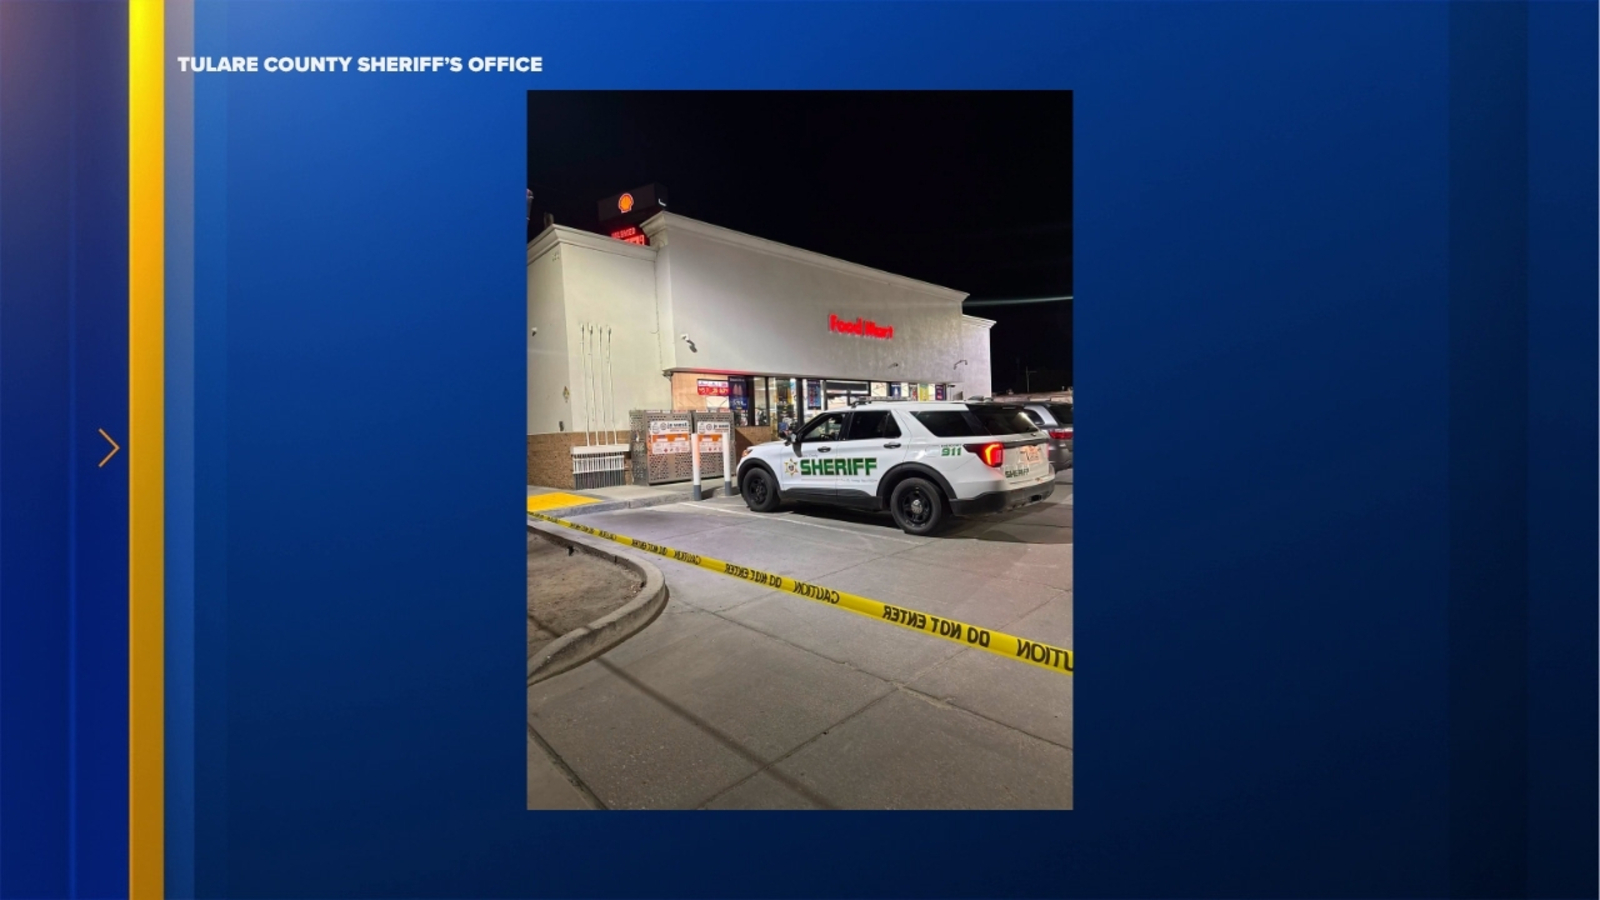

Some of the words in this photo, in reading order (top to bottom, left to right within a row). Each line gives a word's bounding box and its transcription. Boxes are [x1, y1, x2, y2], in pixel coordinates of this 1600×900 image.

[829, 313, 863, 336] Food
[864, 319, 893, 340] Mart
[941, 447, 962, 457] 911
[800, 457, 877, 476] SHERIFF
